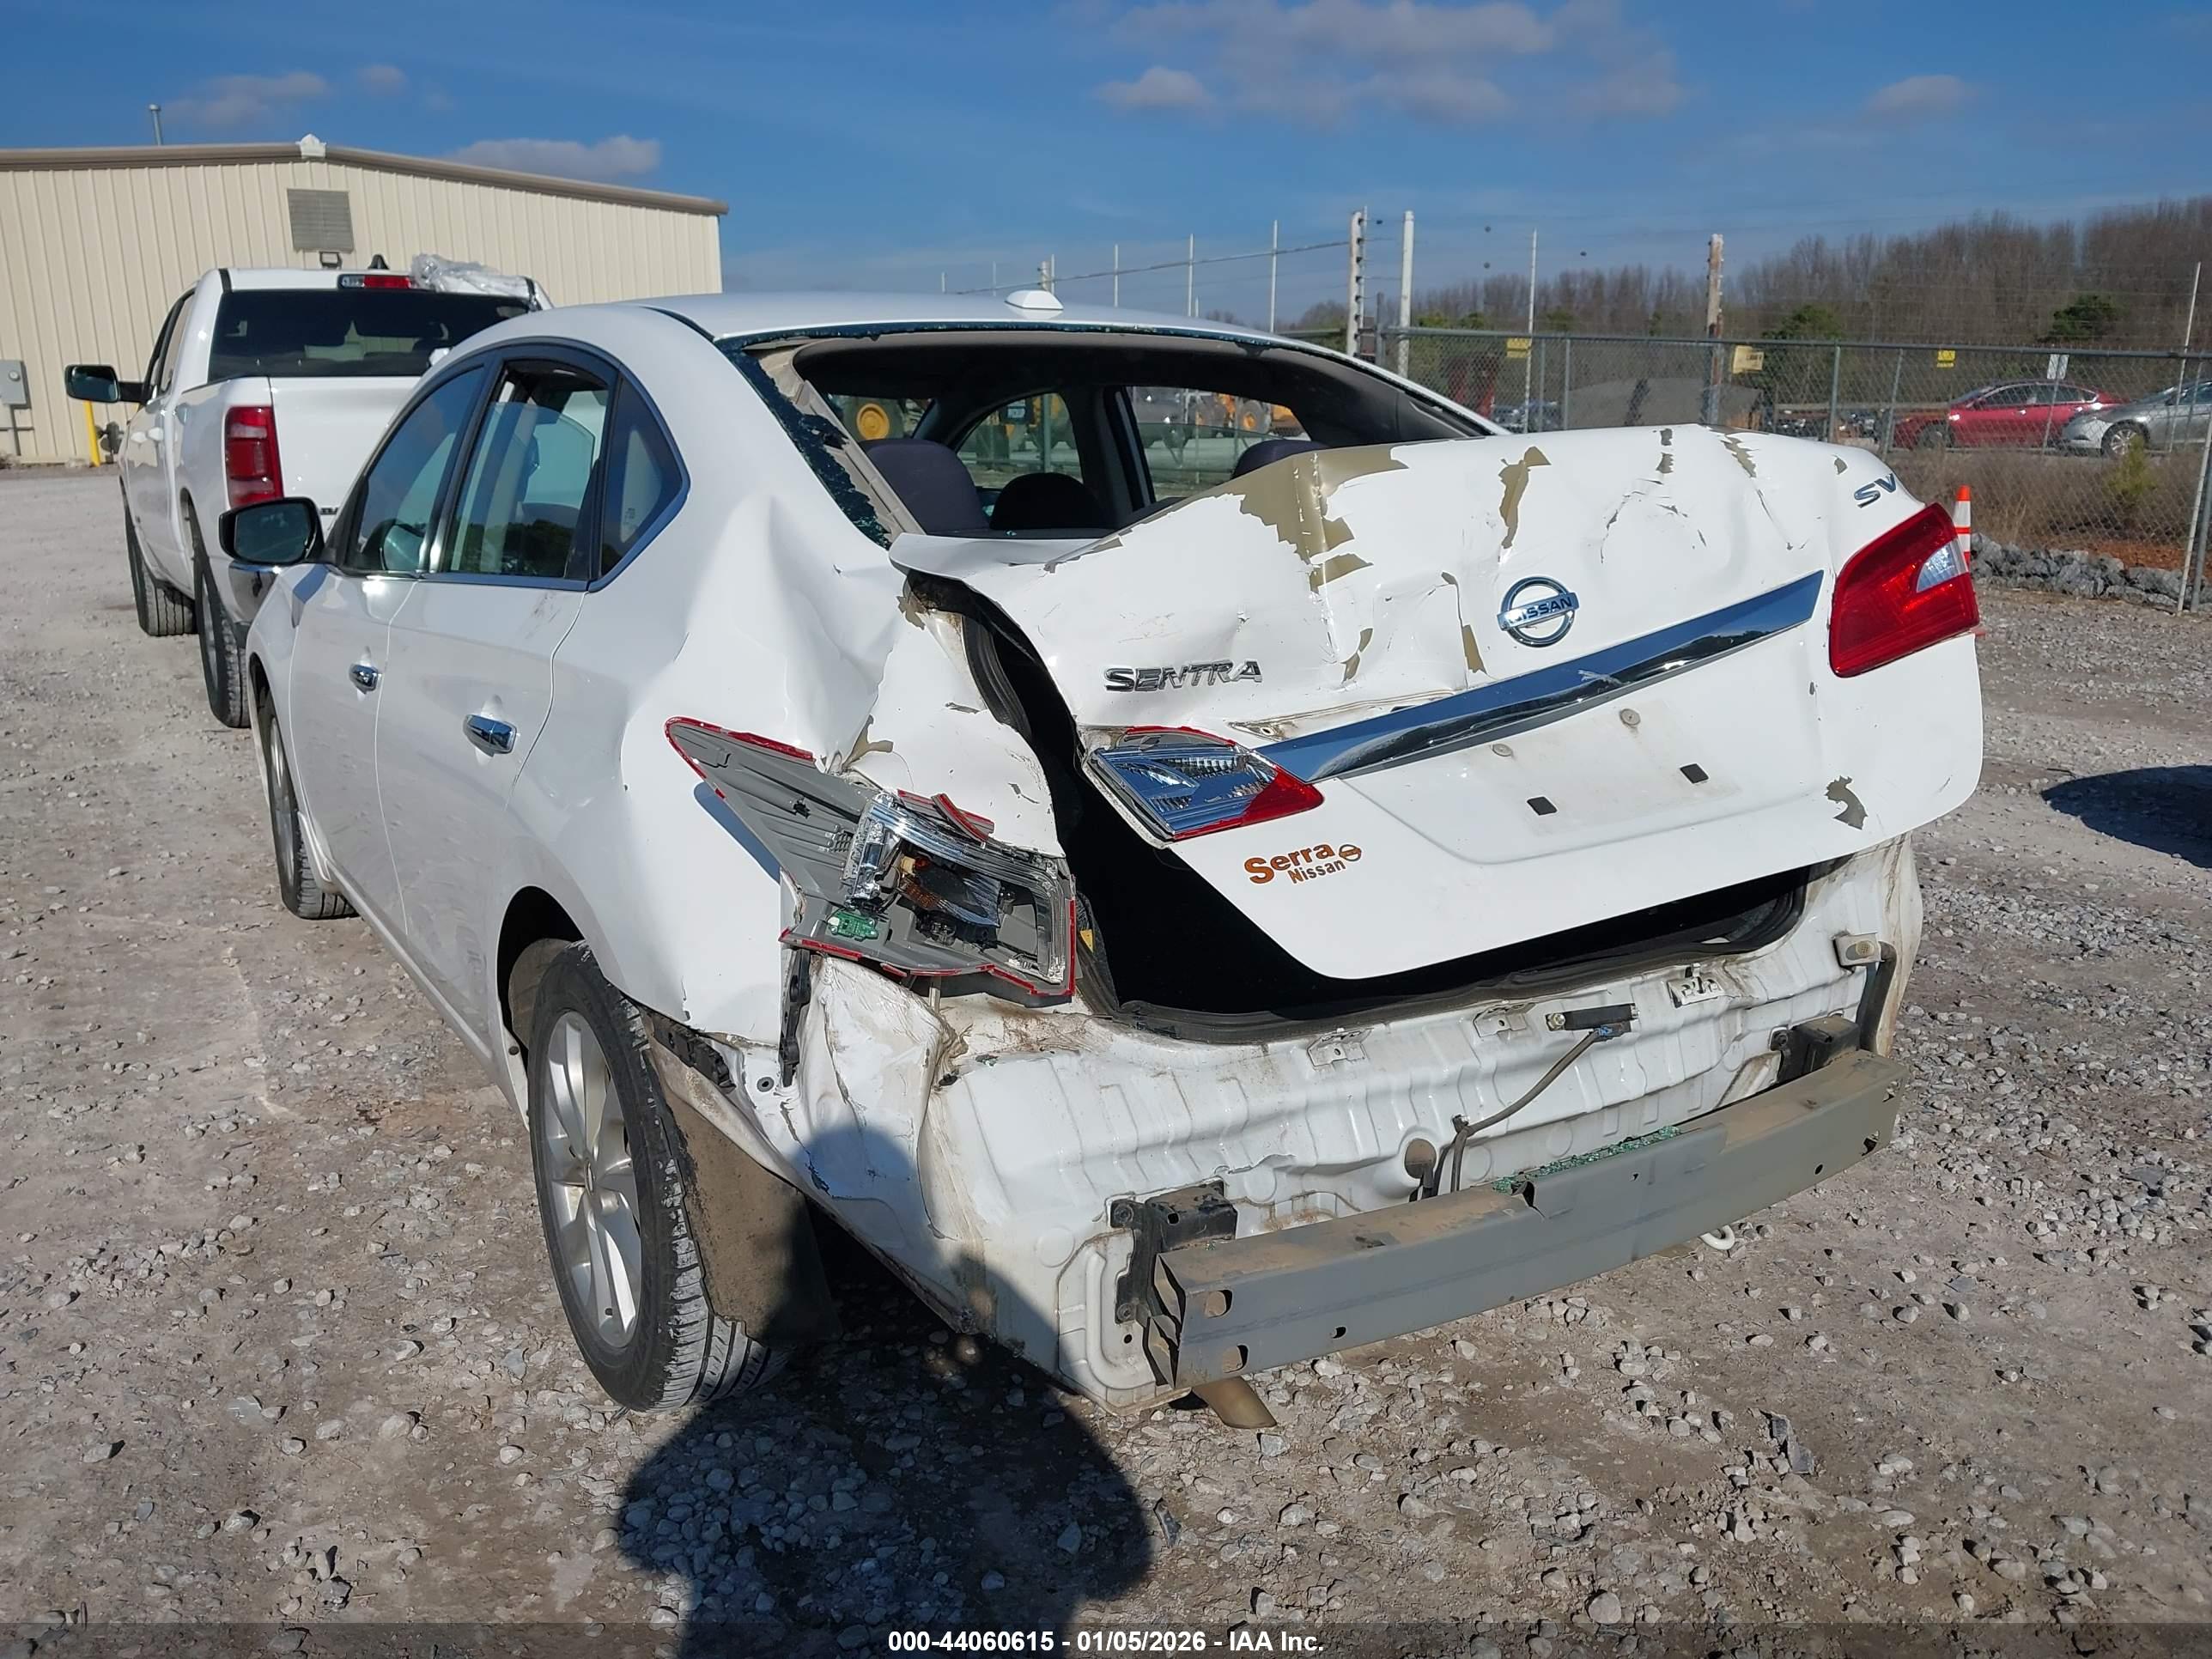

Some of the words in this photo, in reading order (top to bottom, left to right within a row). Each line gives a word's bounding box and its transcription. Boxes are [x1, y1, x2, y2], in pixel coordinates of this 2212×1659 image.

[1854, 472, 1897, 508] SV
[1104, 659, 1263, 692] SENTRA
[1244, 843, 1335, 884] Serra
[1287, 860, 1346, 884] Nissan
